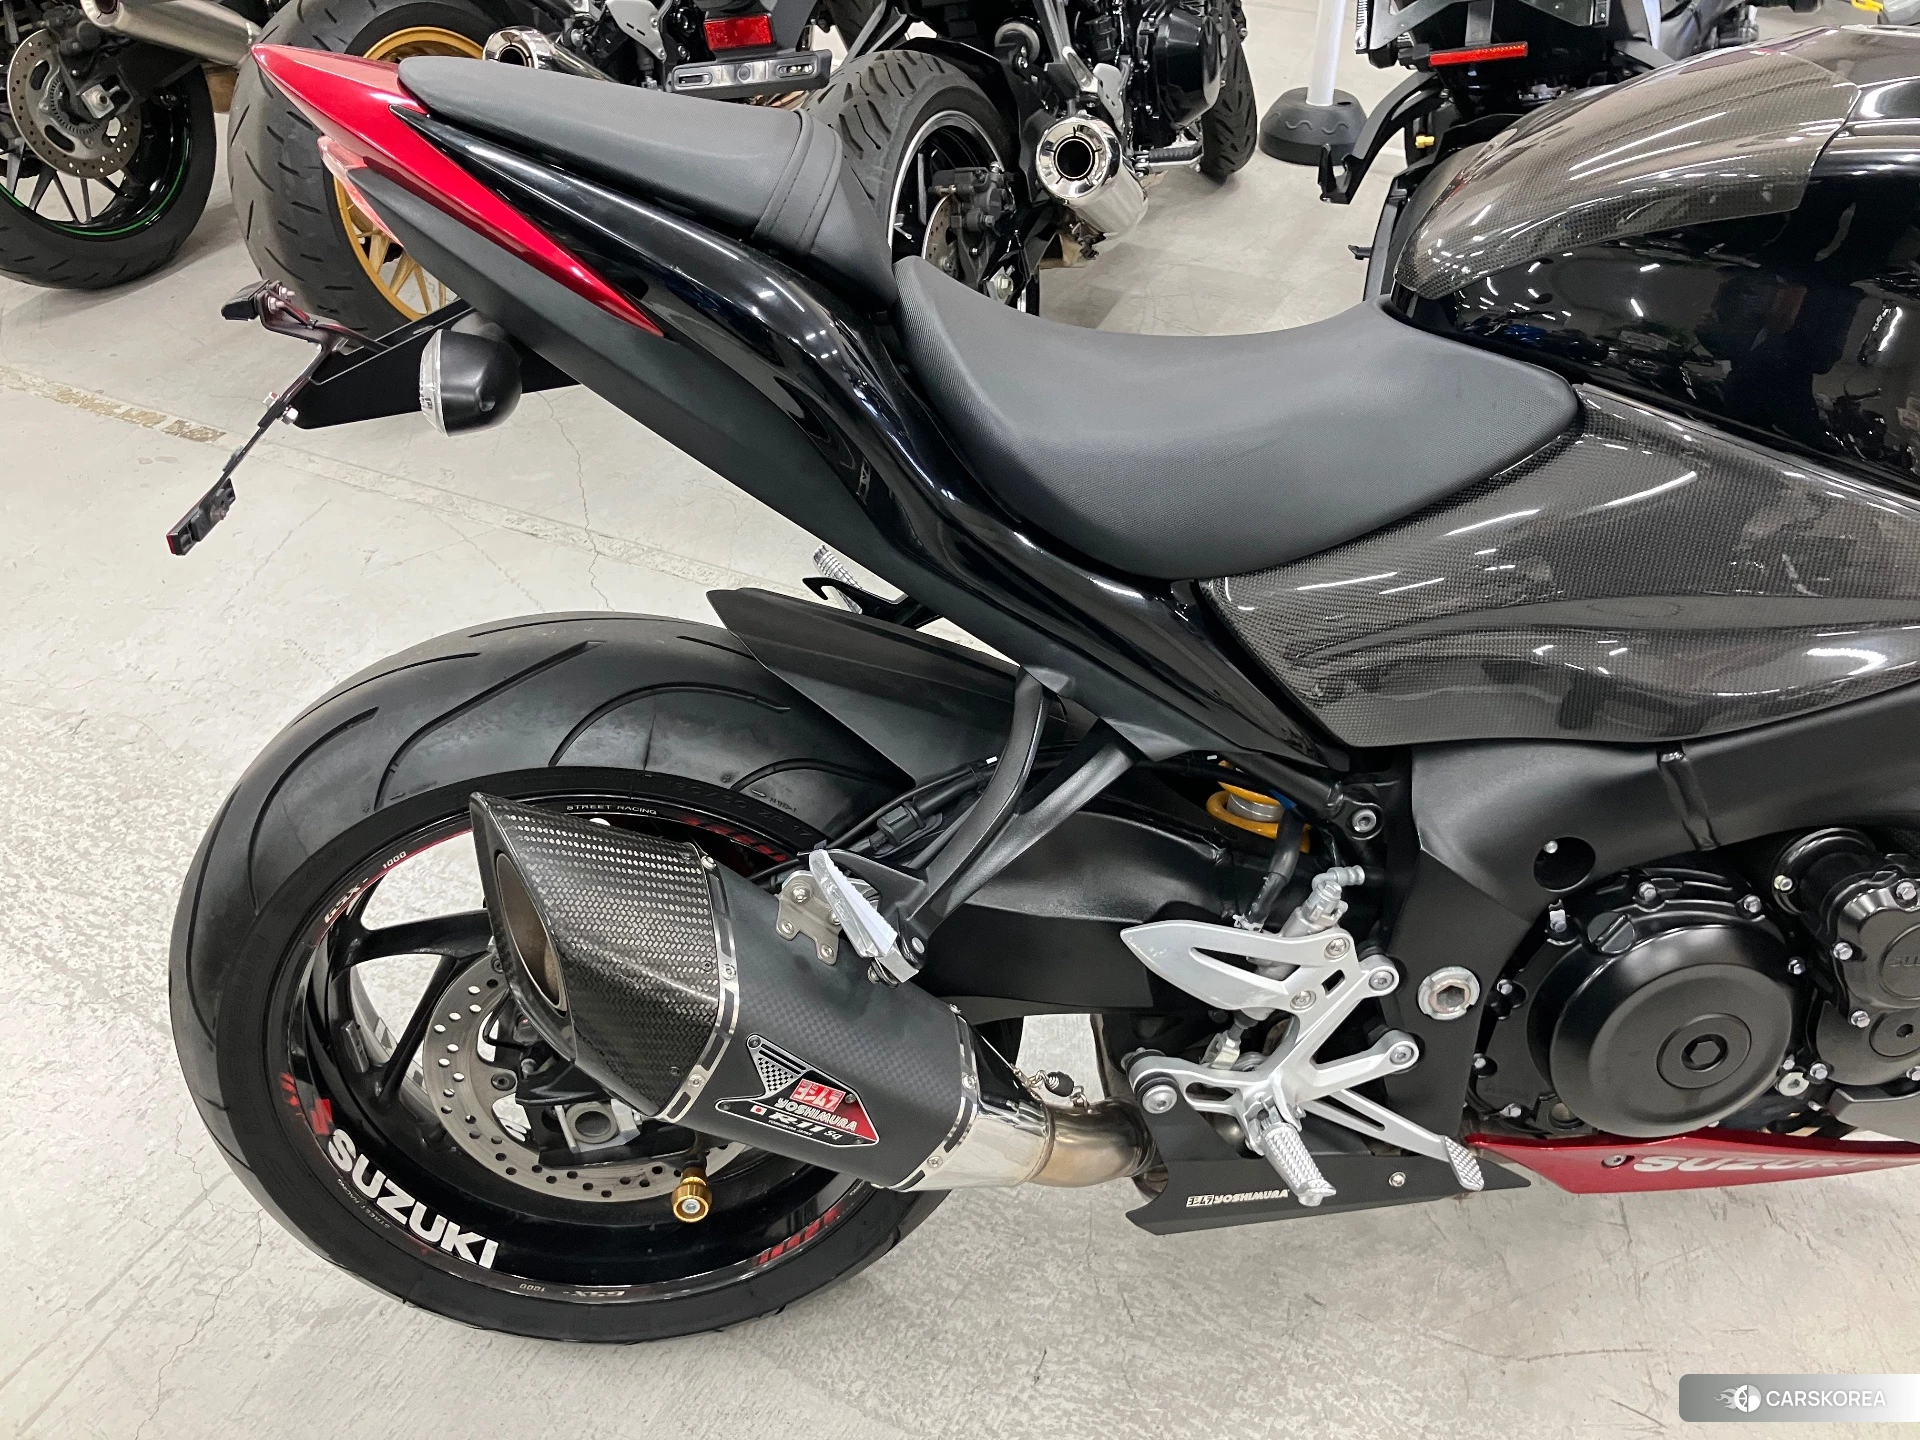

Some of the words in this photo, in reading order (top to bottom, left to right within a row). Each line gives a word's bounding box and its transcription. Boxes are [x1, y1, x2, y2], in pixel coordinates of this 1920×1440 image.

[616, 805, 658, 815] RACING
[382, 850, 407, 869] 1000
[769, 1111, 826, 1133] R-11
[773, 1097, 857, 1131] YOSHIMURA
[328, 1129, 499, 1269] SUZUKI
[1213, 1190, 1289, 1204] YOSHIMURA
[518, 1283, 545, 1292] 1000
